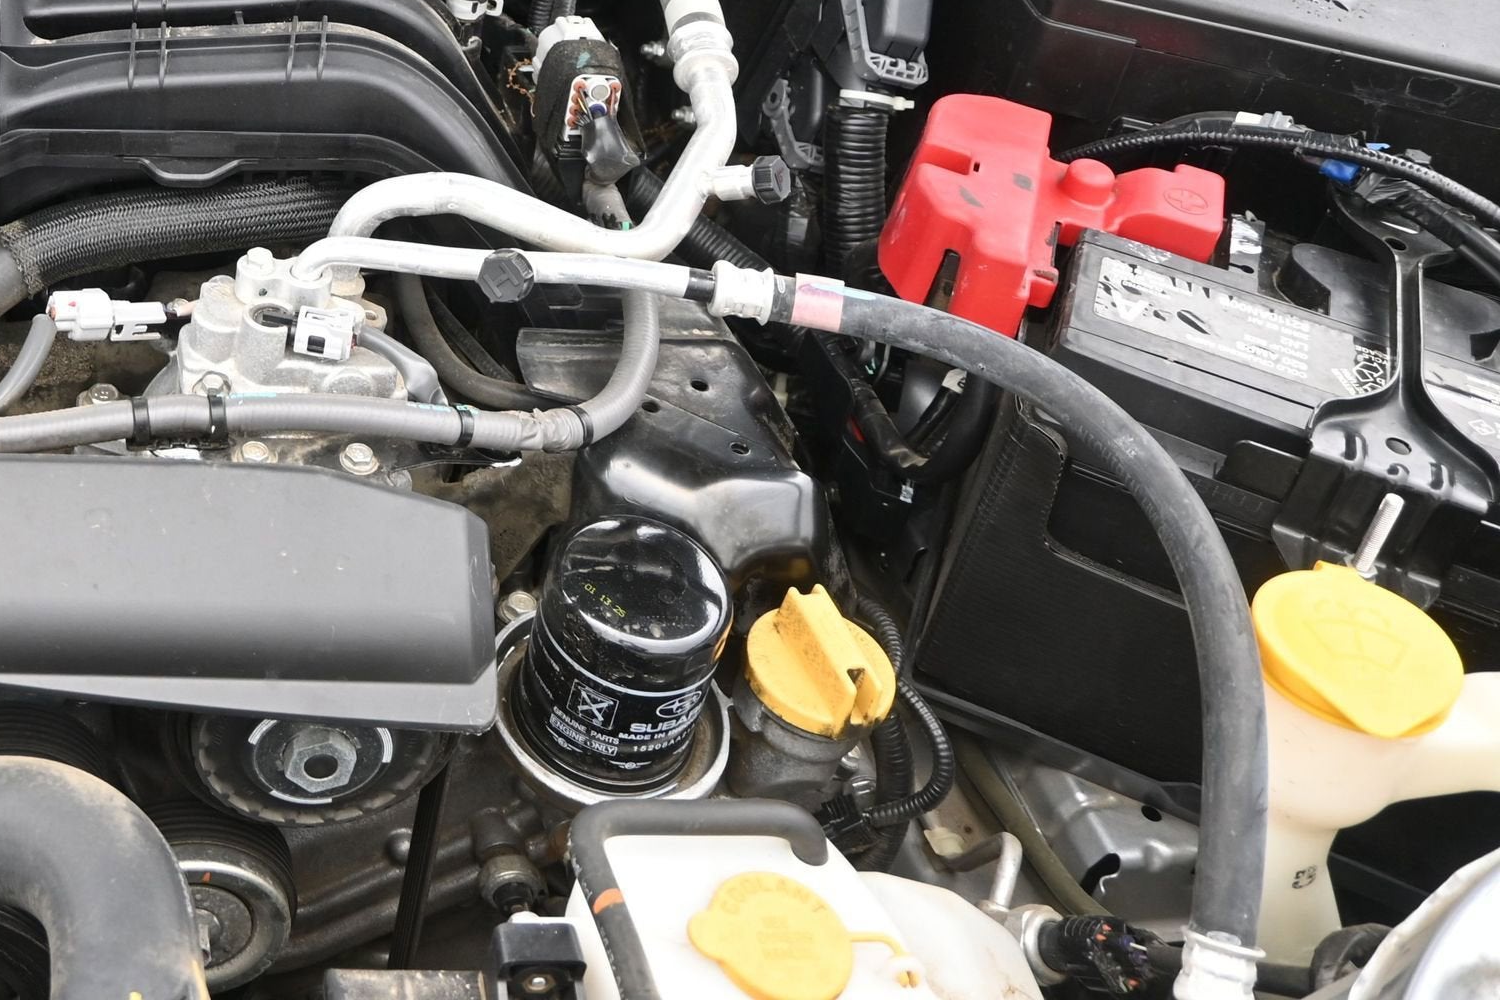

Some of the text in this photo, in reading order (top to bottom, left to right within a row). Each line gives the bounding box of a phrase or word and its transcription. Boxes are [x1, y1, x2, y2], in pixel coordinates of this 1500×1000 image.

[551, 717, 585, 744] ENGINE
[553, 706, 620, 745] GENUINE PARTS
[630, 703, 703, 733] SUBAR
[618, 732, 651, 740] MADE
